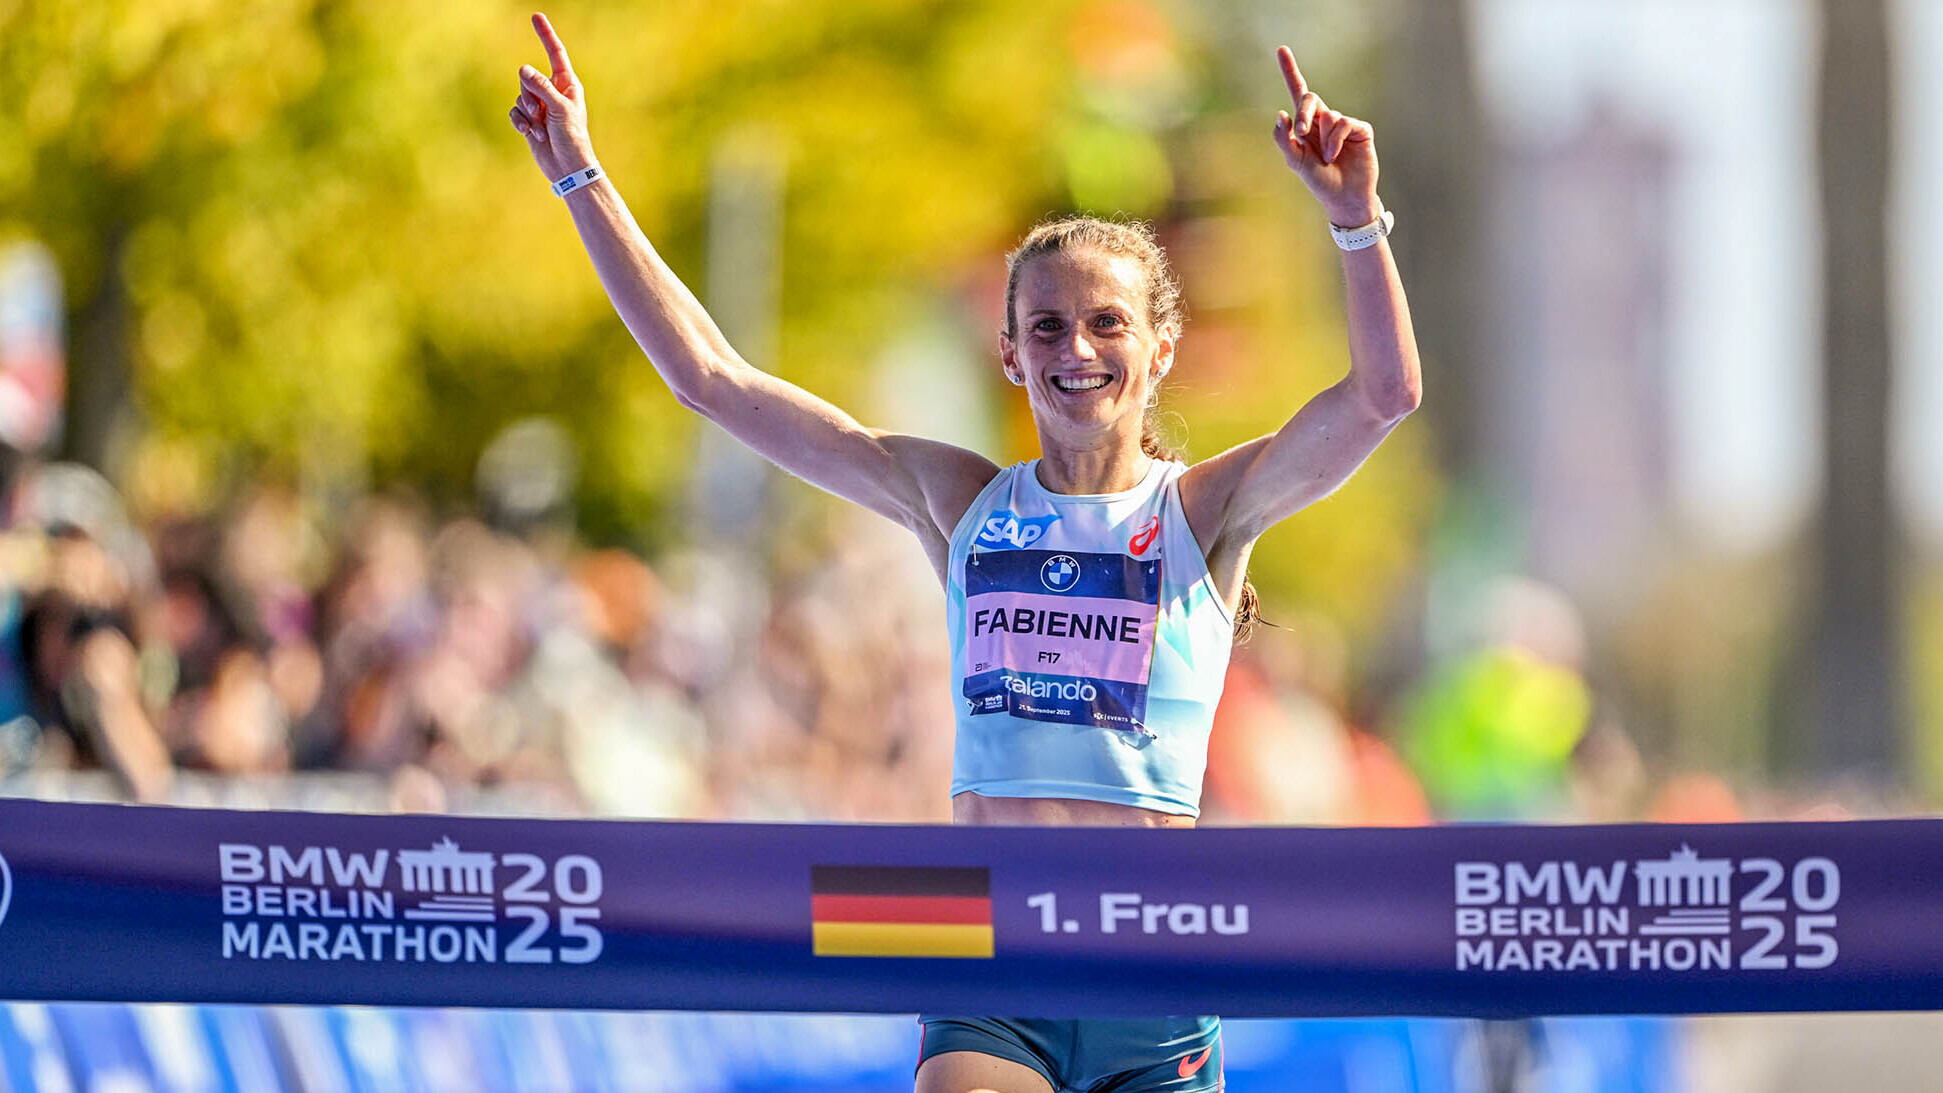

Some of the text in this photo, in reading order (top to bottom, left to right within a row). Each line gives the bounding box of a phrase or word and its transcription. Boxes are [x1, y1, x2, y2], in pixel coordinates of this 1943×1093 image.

[980, 517, 1041, 548] SAP
[973, 608, 1141, 643] FABIENNE
[1038, 652, 1060, 664] F17
[219, 843, 389, 888] BMW
[502, 854, 602, 904] 20
[1455, 861, 1628, 906] BMW
[1740, 857, 1841, 912] 20
[222, 885, 394, 919] BERLIN
[1027, 893, 1249, 935] 1. Frau
[1456, 907, 1629, 936] BERLIN
[222, 922, 497, 963] MARATHON
[504, 906, 604, 964] 25
[1456, 939, 1732, 972] MARATHON
[1740, 915, 1840, 970] 25
